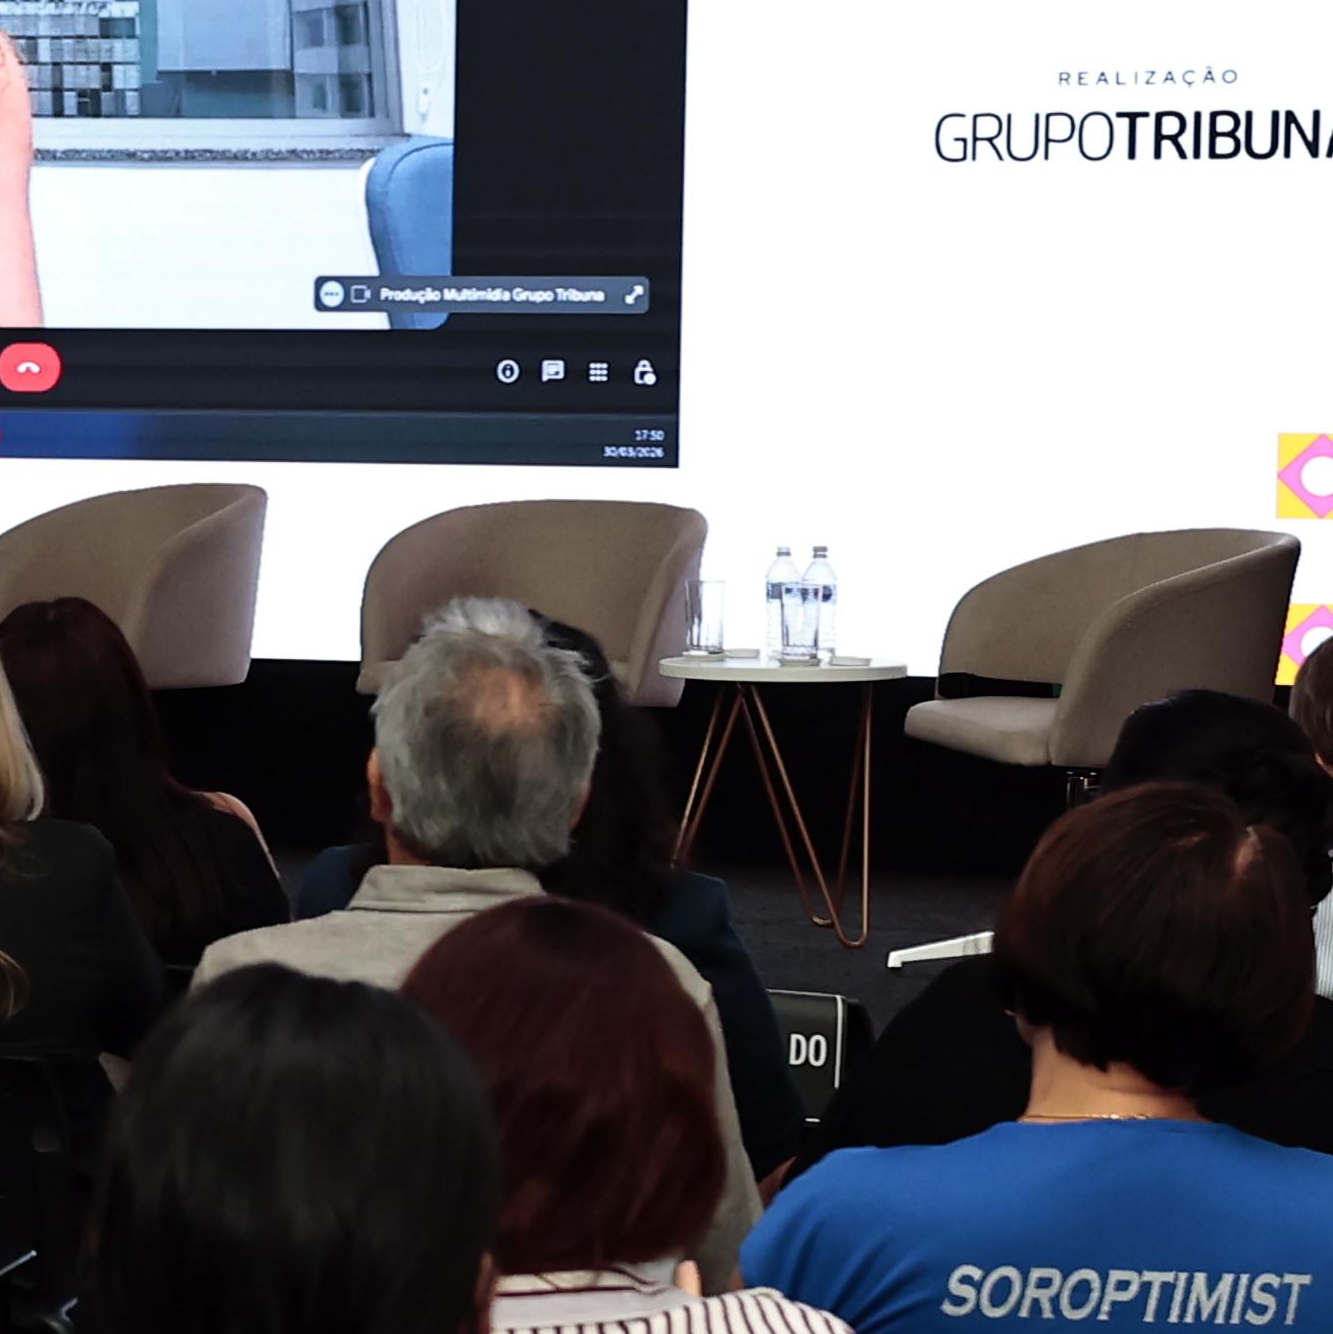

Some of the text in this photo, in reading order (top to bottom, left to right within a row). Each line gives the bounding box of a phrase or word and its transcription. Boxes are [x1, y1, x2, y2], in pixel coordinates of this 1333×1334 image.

[1058, 65, 1239, 89] REALIZAÇÃO
[934, 108, 1333, 163] GRUPOTRIBUN
[380, 287, 441, 304] Produção
[513, 287, 554, 303] Grupo
[555, 287, 605, 303] Tribuna
[940, 1263, 1313, 1326] SOROPTIMIST
